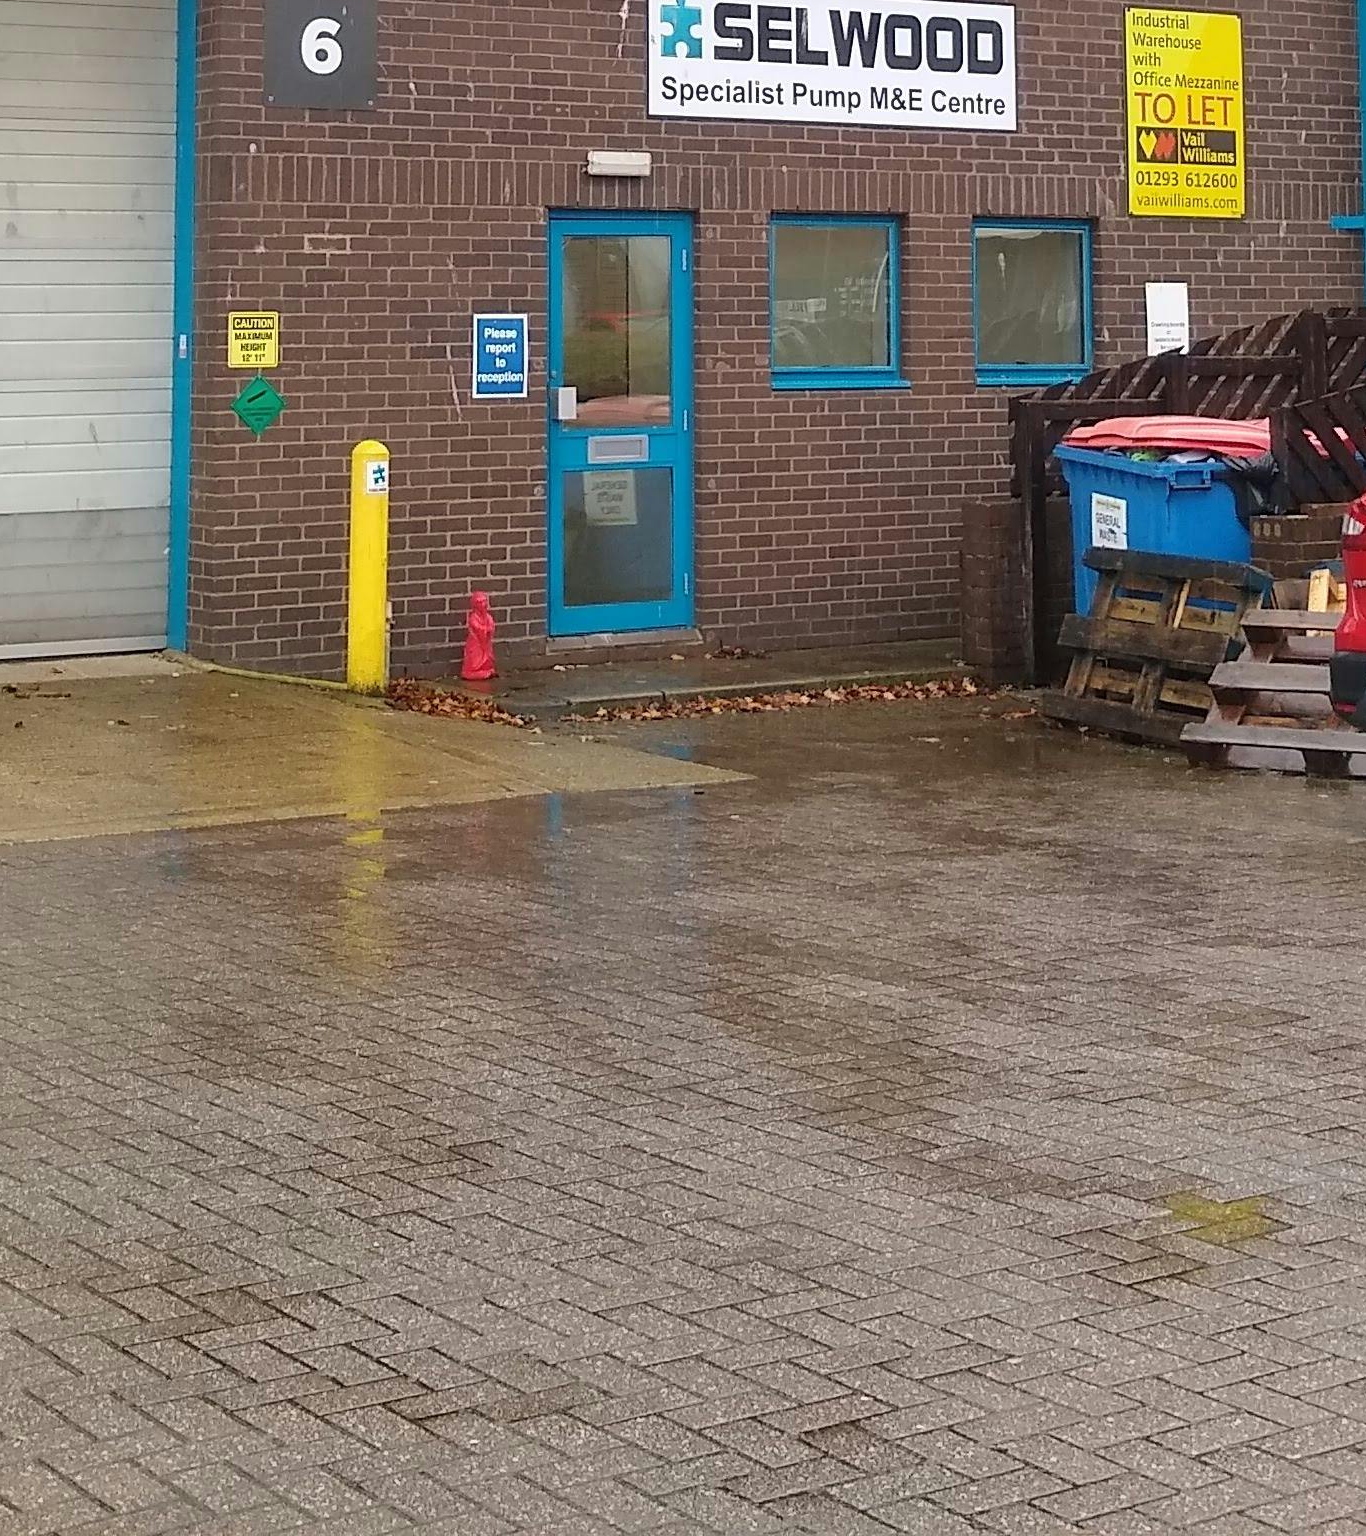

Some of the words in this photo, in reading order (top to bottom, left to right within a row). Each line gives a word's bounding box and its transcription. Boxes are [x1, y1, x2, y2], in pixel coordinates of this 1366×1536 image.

[1132, 12, 1189, 30] Industrial
[300, 17, 343, 75] 6
[713, 2, 1004, 75] SELWOOD
[1133, 32, 1202, 50] Warehouse
[1133, 52, 1161, 67] with
[1134, 71, 1171, 88] Office
[1175, 74, 1239, 91] Mezzanine
[661, 76, 784, 106] Specialist
[792, 82, 861, 113] Pump
[870, 86, 923, 112] M&E
[931, 89, 1006, 115] Centre
[1134, 92, 1176, 124] TO
[1188, 95, 1234, 126] LET
[1182, 131, 1205, 147] Vail
[1182, 147, 1235, 164] Williams
[1135, 170, 1179, 187] 01293
[1185, 172, 1238, 188] 612600
[234, 318, 274, 329] CAUTION
[235, 332, 273, 341] MAXIMUM
[484, 327, 517, 339] Please
[240, 343, 267, 352] HEIGHT
[485, 342, 517, 356] report
[495, 357, 507, 368] to
[477, 371, 524, 384] reception
[1095, 512, 1121, 529] GENERAL
